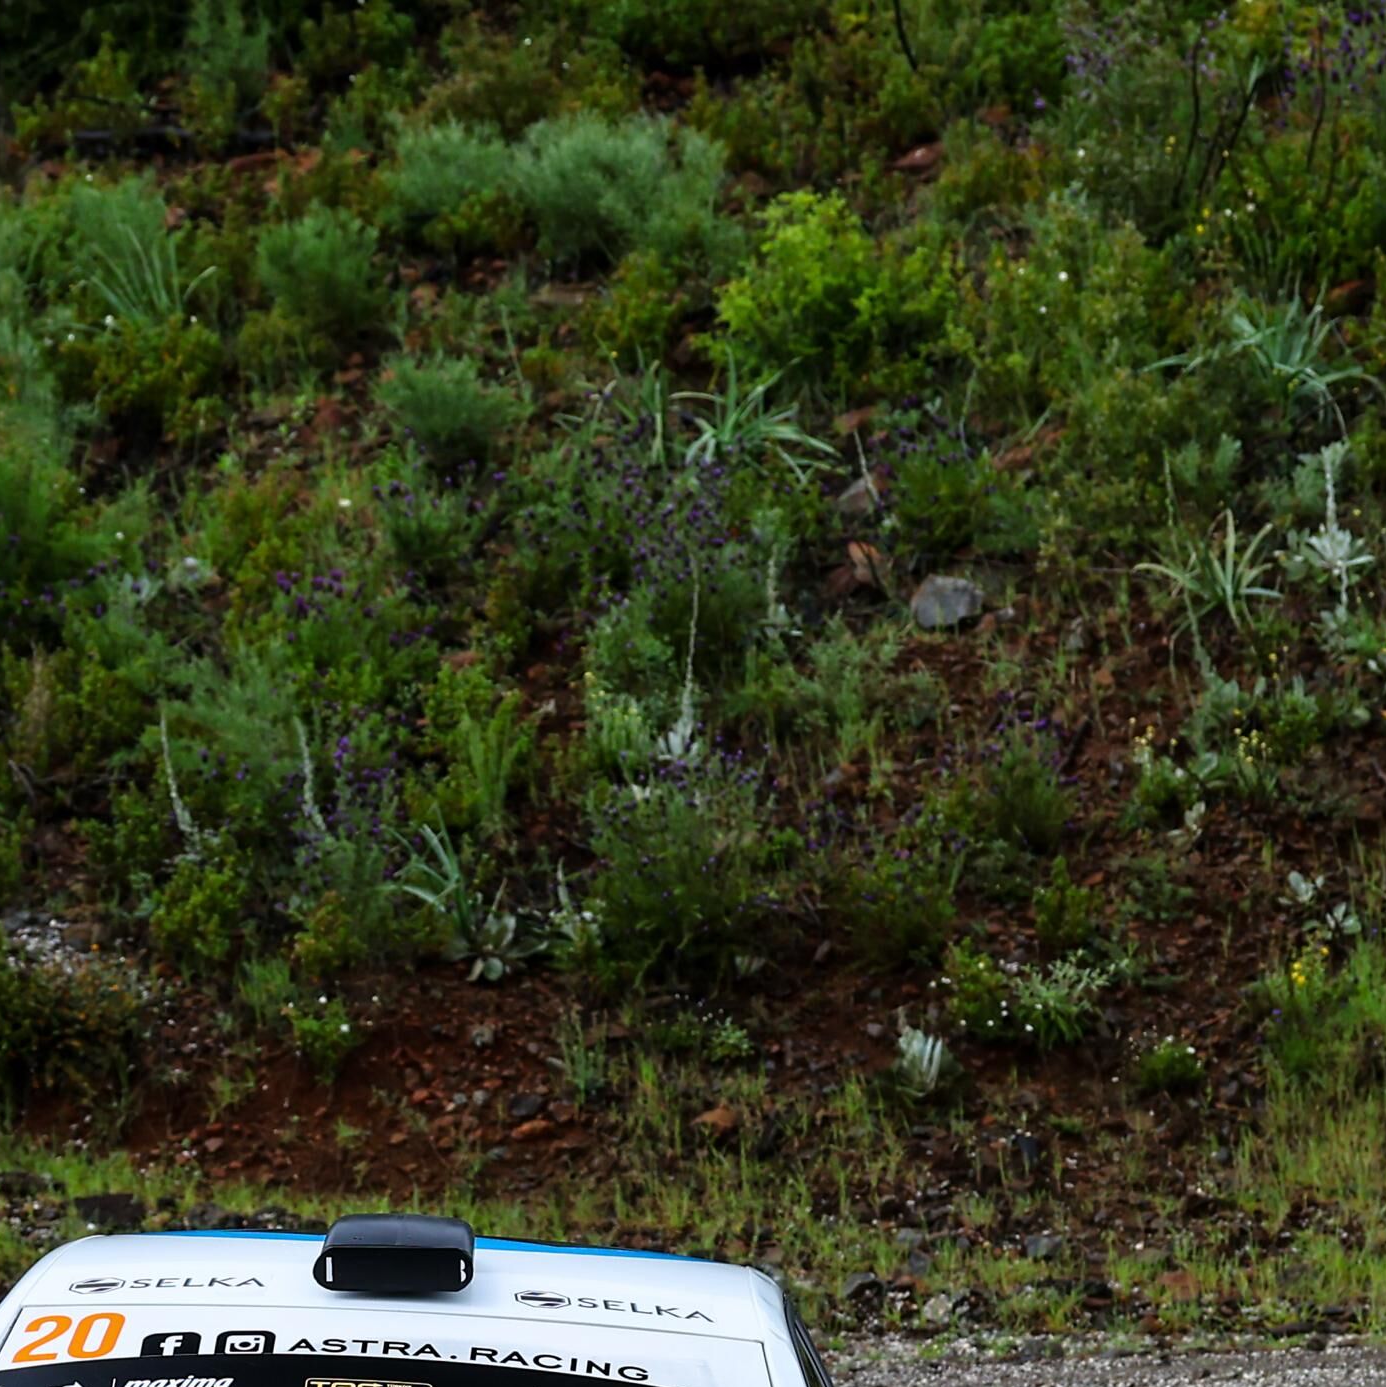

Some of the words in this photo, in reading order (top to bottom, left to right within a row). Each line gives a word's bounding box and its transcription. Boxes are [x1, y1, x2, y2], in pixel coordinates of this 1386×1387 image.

[129, 1277, 265, 1288] SELKA
[577, 1297, 715, 1323] SELKA
[12, 1312, 126, 1363] 20
